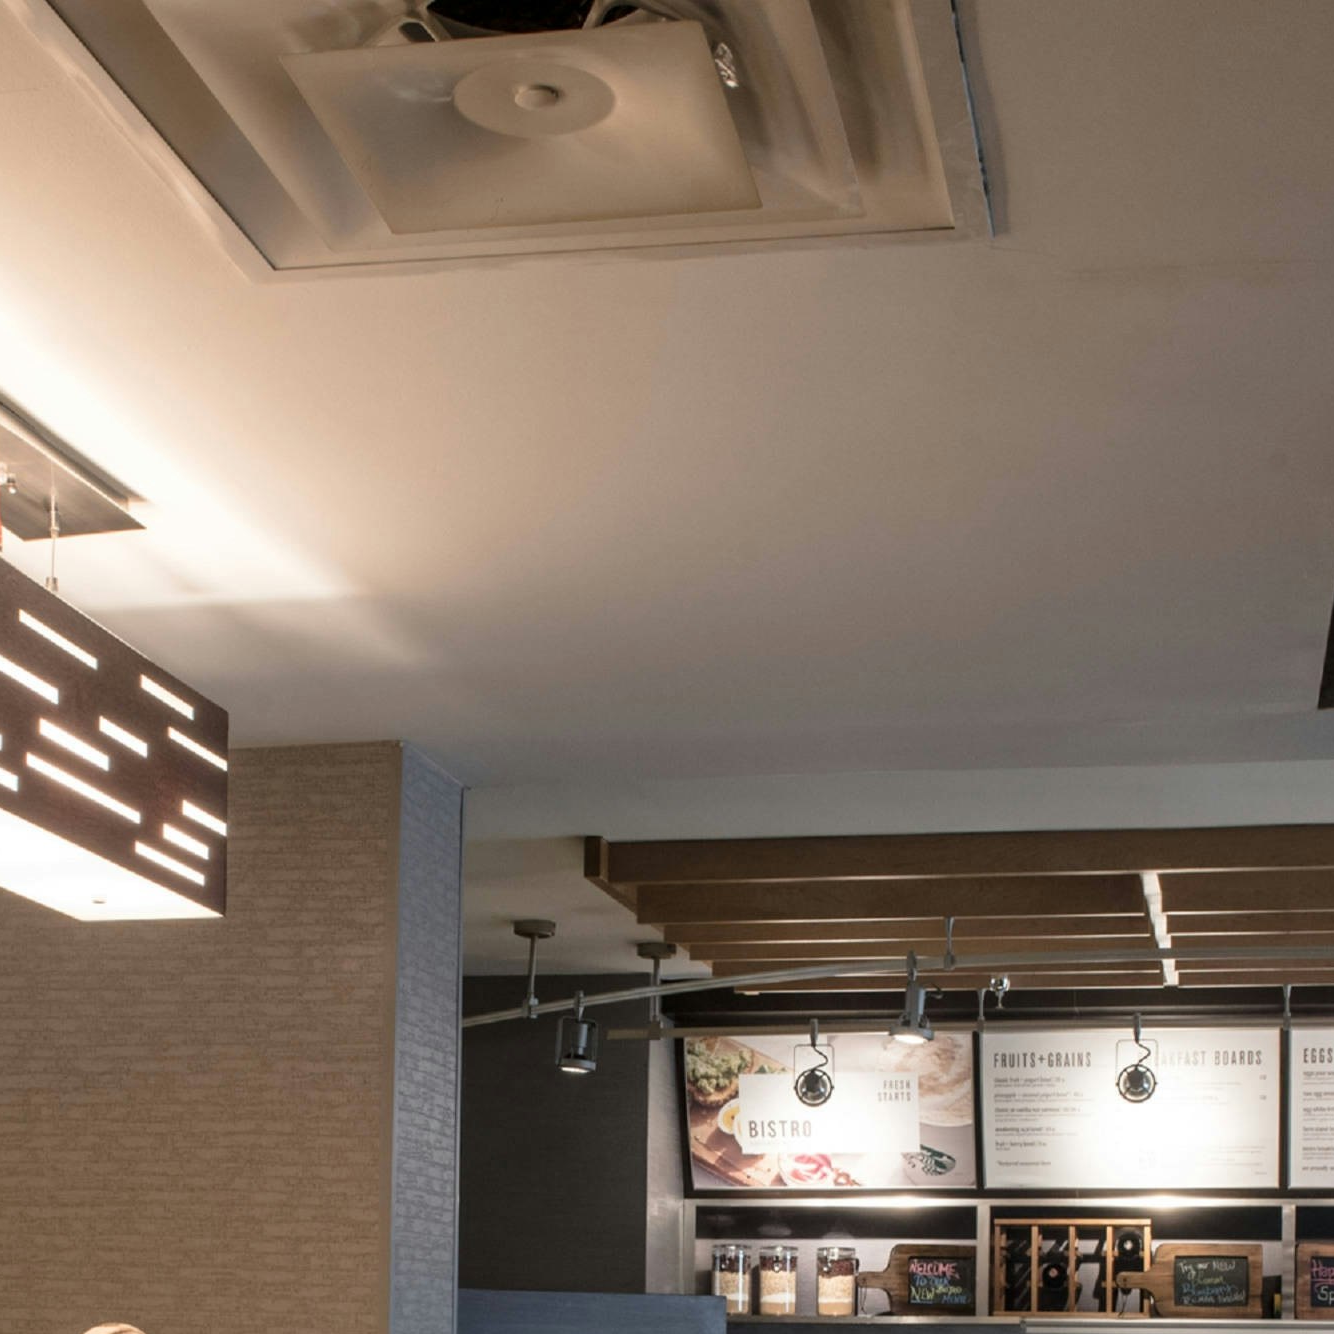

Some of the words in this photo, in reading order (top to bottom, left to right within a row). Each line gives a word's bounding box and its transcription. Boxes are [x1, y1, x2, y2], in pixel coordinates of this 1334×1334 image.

[994, 1051, 1092, 1068] FRUITS+GRAINS
[1214, 1049, 1263, 1066] BOARDS
[1303, 1047, 1334, 1064] EGGS
[883, 1079, 911, 1090] FRESH
[877, 1091, 911, 1102] STARTS
[748, 1119, 812, 1138] BISTRO
[909, 1260, 959, 1278] WELCOME
[910, 1285, 936, 1302] NEW
